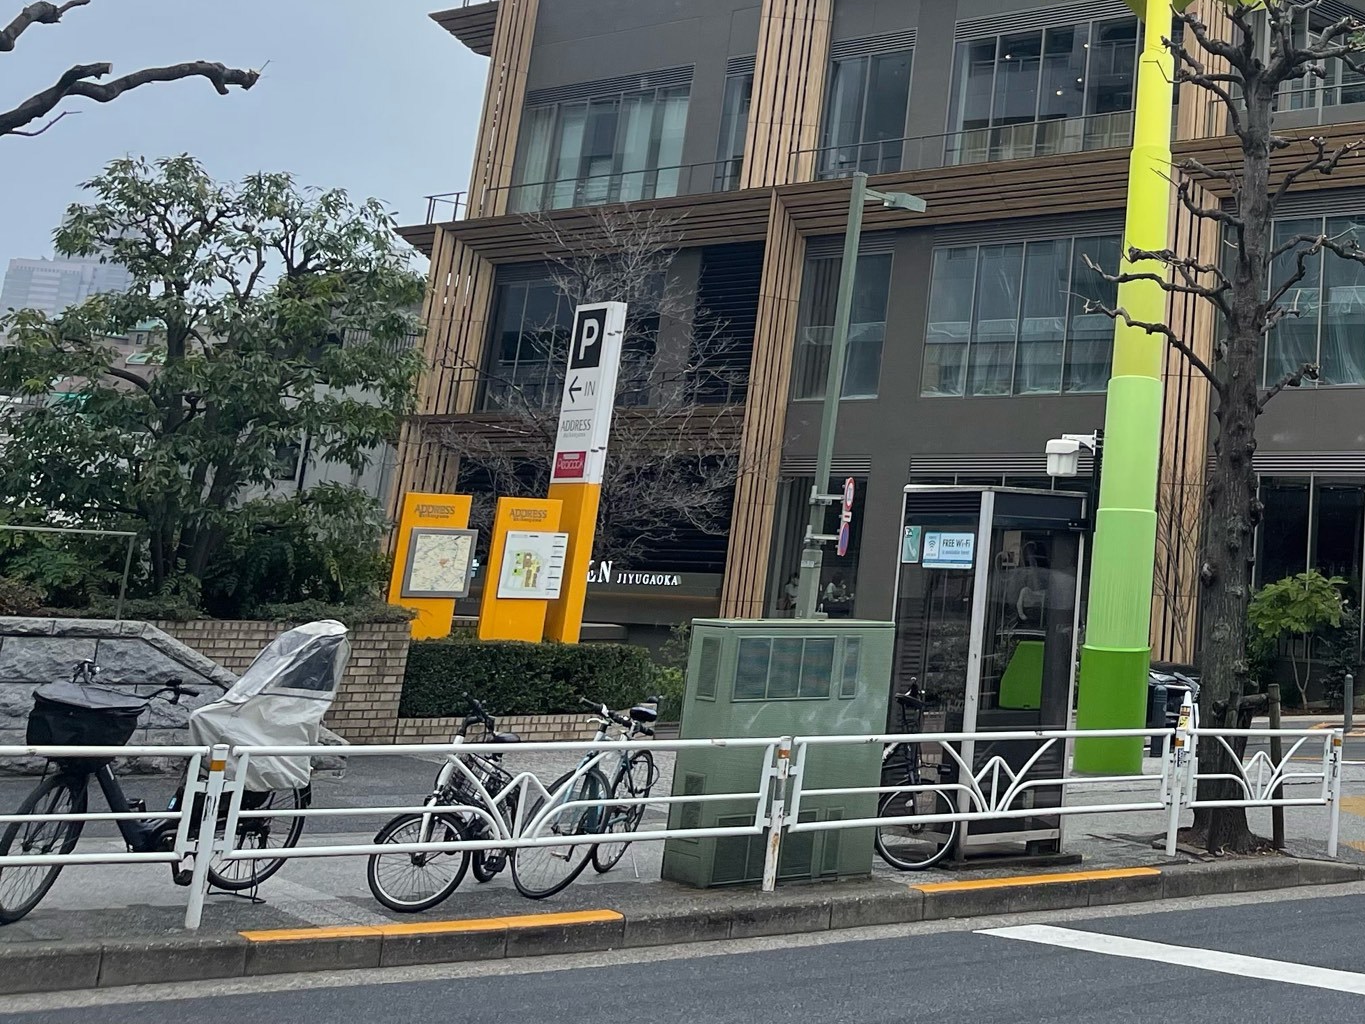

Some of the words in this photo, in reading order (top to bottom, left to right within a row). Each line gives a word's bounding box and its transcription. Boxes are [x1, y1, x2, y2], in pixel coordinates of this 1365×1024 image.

[579, 318, 599, 360] P
[584, 381, 596, 396] IN
[561, 419, 591, 431] ADDRESS
[414, 504, 455, 515] ADDRESS
[509, 508, 547, 518] ADDRESS
[942, 539, 955, 547] FREE
[956, 539, 971, 548] Wi-Fi
[616, 573, 679, 586] JIYUGAOKA
